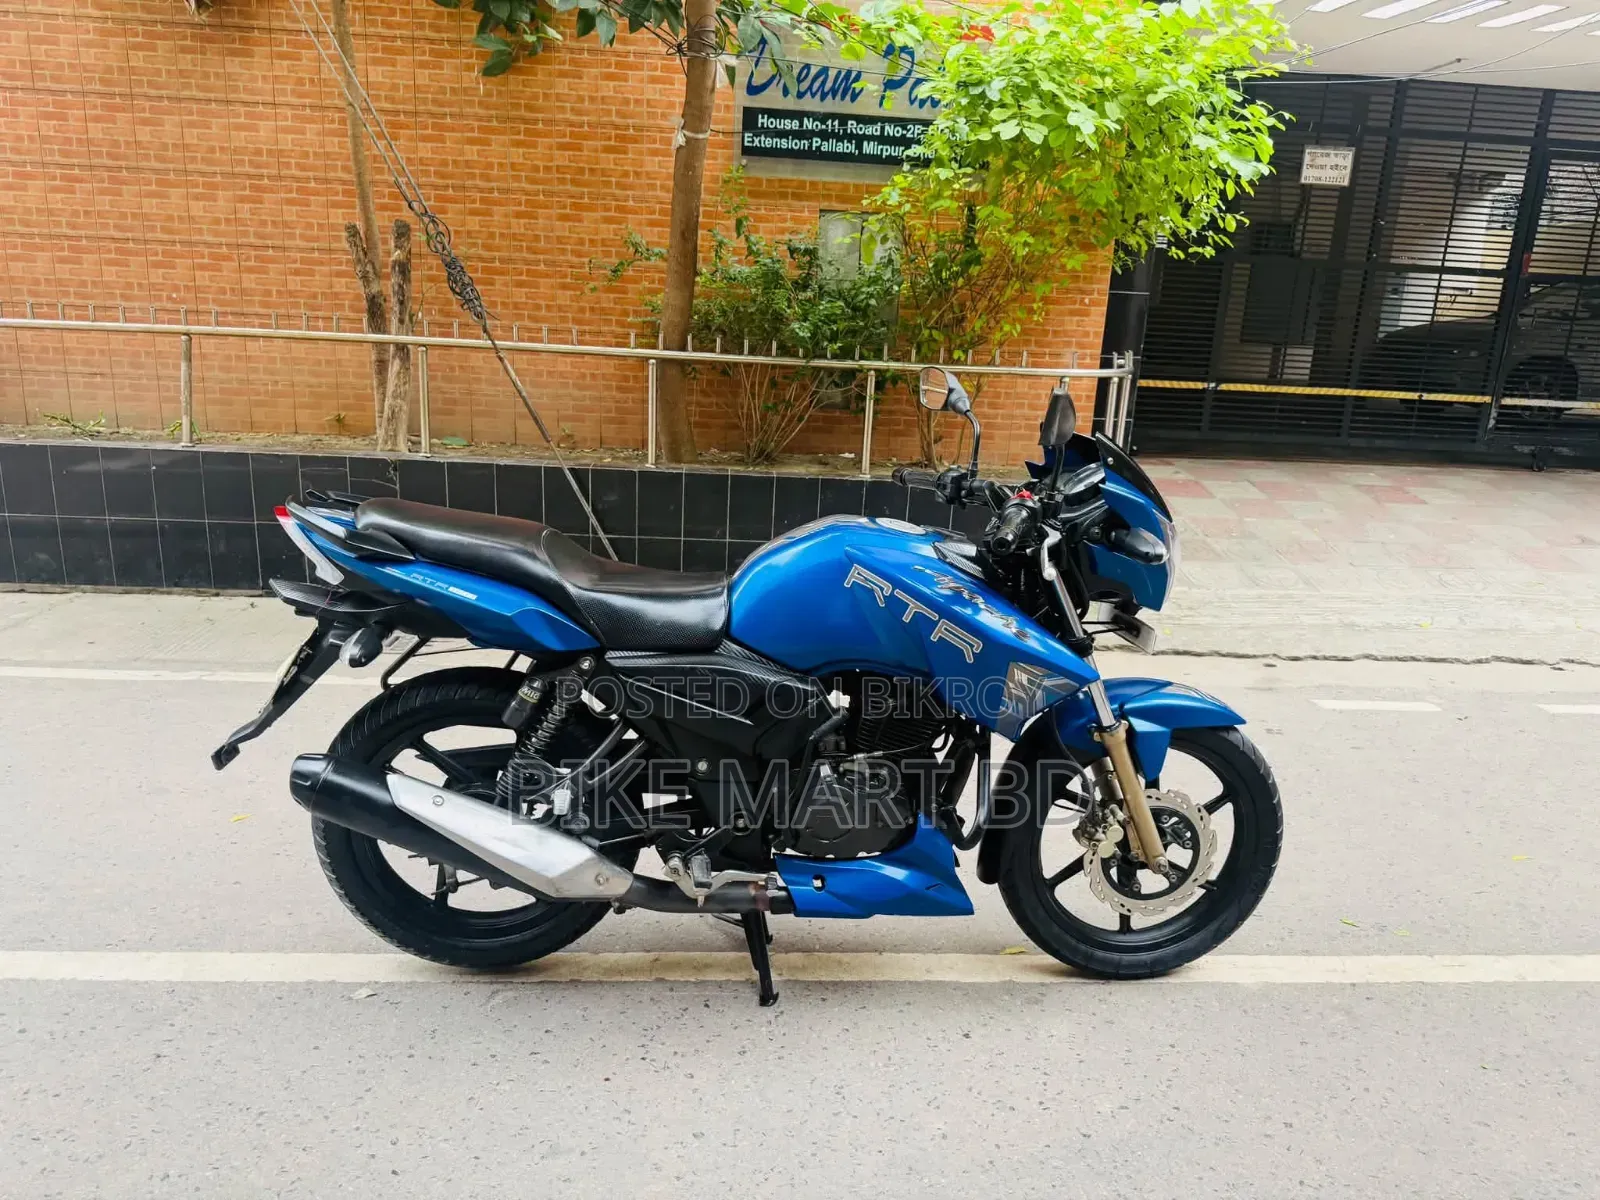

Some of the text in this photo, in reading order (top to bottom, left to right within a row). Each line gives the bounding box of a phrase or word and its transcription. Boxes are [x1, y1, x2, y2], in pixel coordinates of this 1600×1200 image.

[757, 113, 799, 130] House
[803, 117, 844, 136] No-11,
[847, 120, 881, 136] Road
[744, 132, 808, 151] Extension
[812, 137, 859, 156] Pallabi,
[844, 563, 983, 664] RTR
